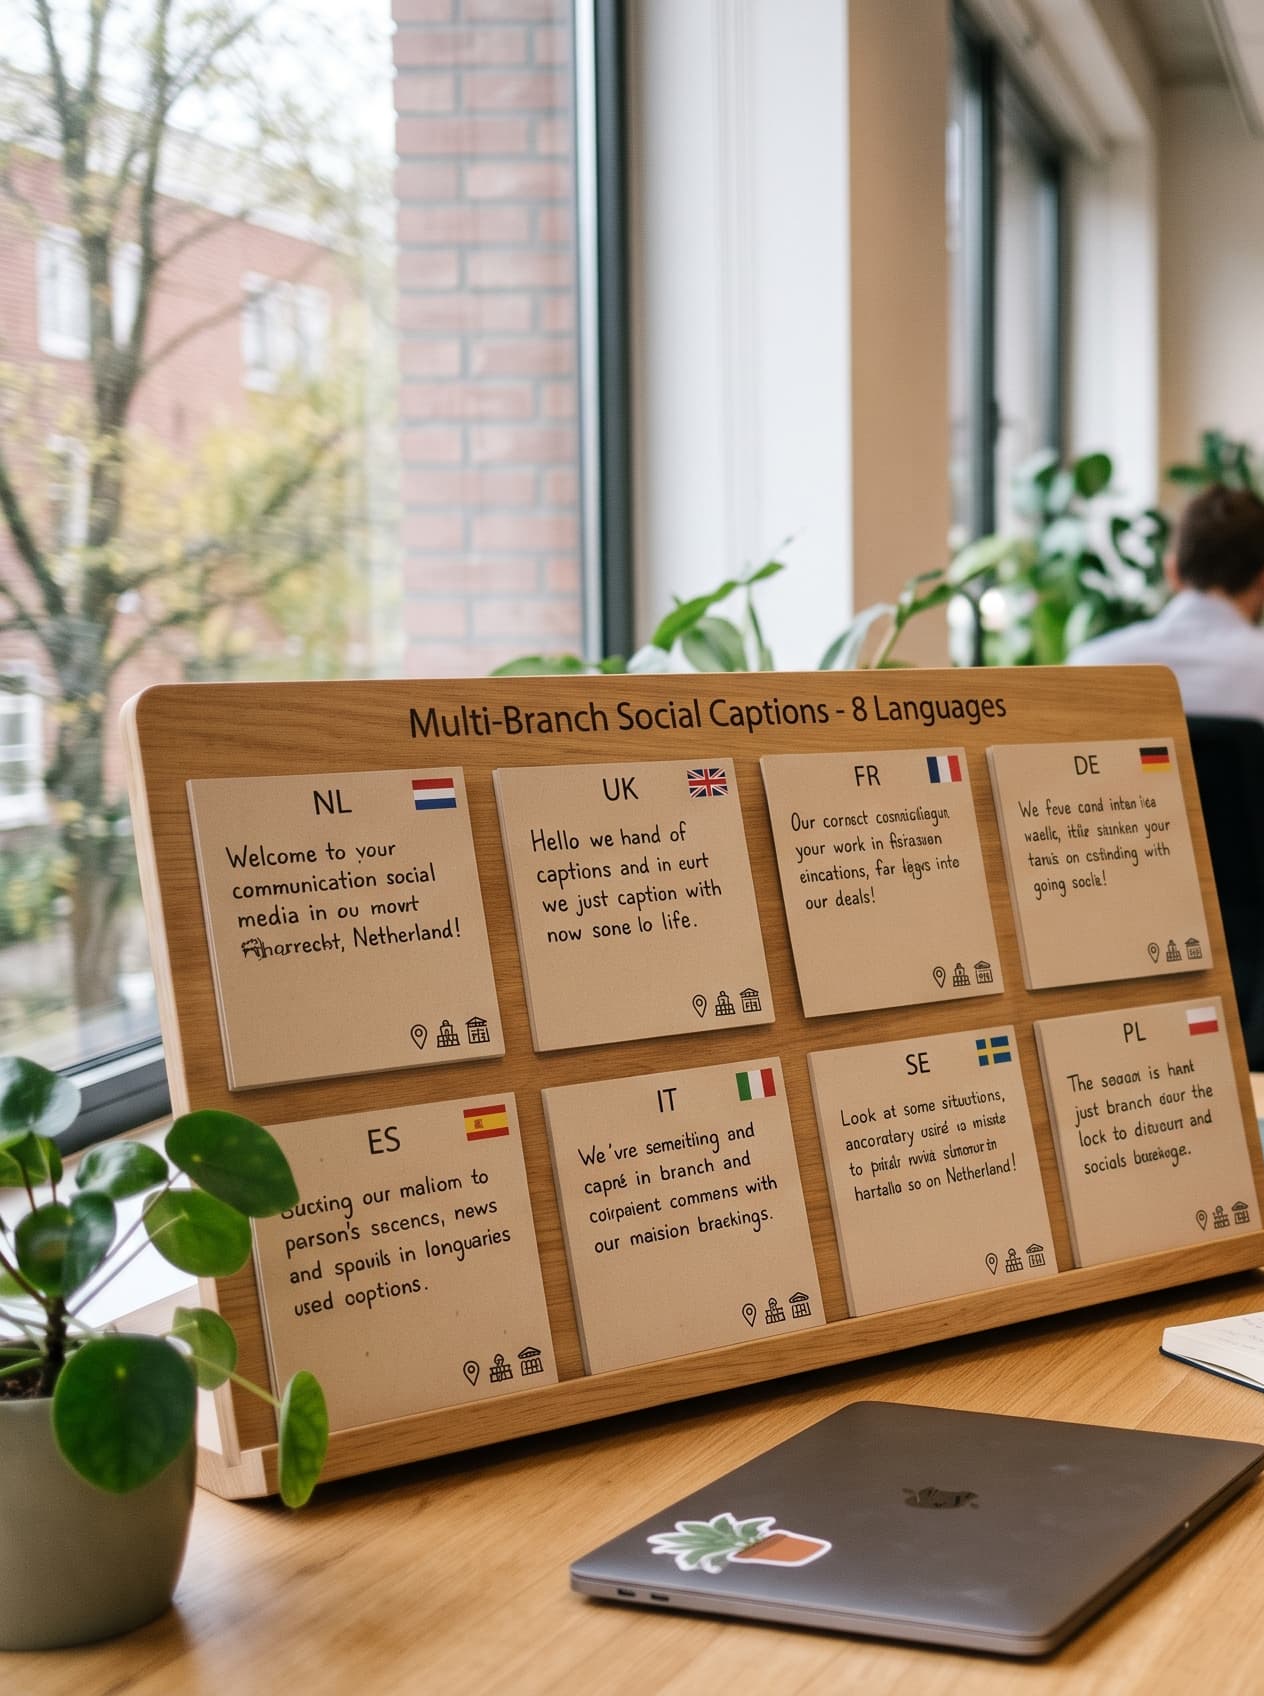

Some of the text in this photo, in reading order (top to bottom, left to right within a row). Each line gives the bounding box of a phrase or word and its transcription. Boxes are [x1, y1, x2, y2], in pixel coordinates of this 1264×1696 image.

[409, 701, 609, 739] Multi-Branch
[616, 698, 702, 731] Social
[709, 697, 829, 734] Captions
[851, 695, 868, 722] 8
[873, 694, 1007, 727] Languages
[854, 764, 881, 787] FR
[1073, 754, 1100, 776] DE
[312, 789, 353, 815] NL
[602, 776, 639, 802] UK
[791, 811, 816, 832] Our
[1017, 799, 1039, 818] We
[530, 820, 687, 852] Hello we hand of
[1144, 821, 1170, 839] your
[225, 841, 396, 869] Welcome to your
[795, 844, 826, 864] your
[833, 835, 866, 854] work
[870, 836, 884, 850] in
[1065, 854, 1080, 864] on
[1144, 842, 1170, 857] with
[232, 861, 436, 900] communication social
[536, 861, 612, 890] captions
[620, 855, 650, 876] and
[656, 856, 672, 872] in
[875, 858, 896, 877] far
[542, 878, 722, 917] we just caption with
[805, 885, 876, 910] our deals!
[1033, 878, 1067, 901] going
[237, 903, 299, 928] media
[308, 904, 327, 921] in
[337, 906, 359, 919] ou
[547, 928, 582, 943] now
[592, 922, 632, 938] sone
[661, 909, 697, 930] life.
[352, 916, 461, 948] Netherland!
[1123, 1021, 1147, 1043] PL
[905, 1051, 931, 1076] SE
[1066, 1073, 1094, 1092] The
[1148, 1065, 1160, 1080] is
[657, 1087, 677, 1113] IT
[1075, 1102, 1100, 1128] just
[1105, 1093, 1152, 1115] branch
[1191, 1084, 1213, 1099] the
[840, 1107, 877, 1127] Look
[883, 1104, 897, 1120] at
[903, 1102, 936, 1116] some
[1078, 1129, 1107, 1147] lock
[1112, 1125, 1127, 1141] to
[1189, 1108, 1213, 1127] and
[367, 1125, 401, 1155] ES
[727, 1121, 755, 1141] and
[634, 1170, 651, 1186] in
[659, 1157, 715, 1181] branch
[723, 1149, 751, 1170] and
[848, 1162, 863, 1177] to
[908, 1180, 922, 1191] so
[926, 1176, 941, 1188] on
[945, 1151, 1017, 1184] Netherland!
[1084, 1152, 1127, 1175] socials
[362, 1189, 391, 1205] our
[470, 1168, 489, 1185] to
[669, 1185, 738, 1209] commens
[745, 1174, 778, 1194] with
[454, 1200, 498, 1220] news
[594, 1237, 620, 1254] our
[629, 1223, 690, 1246] maision
[289, 1259, 323, 1284] and
[398, 1246, 416, 1263] in
[294, 1290, 334, 1317] used
